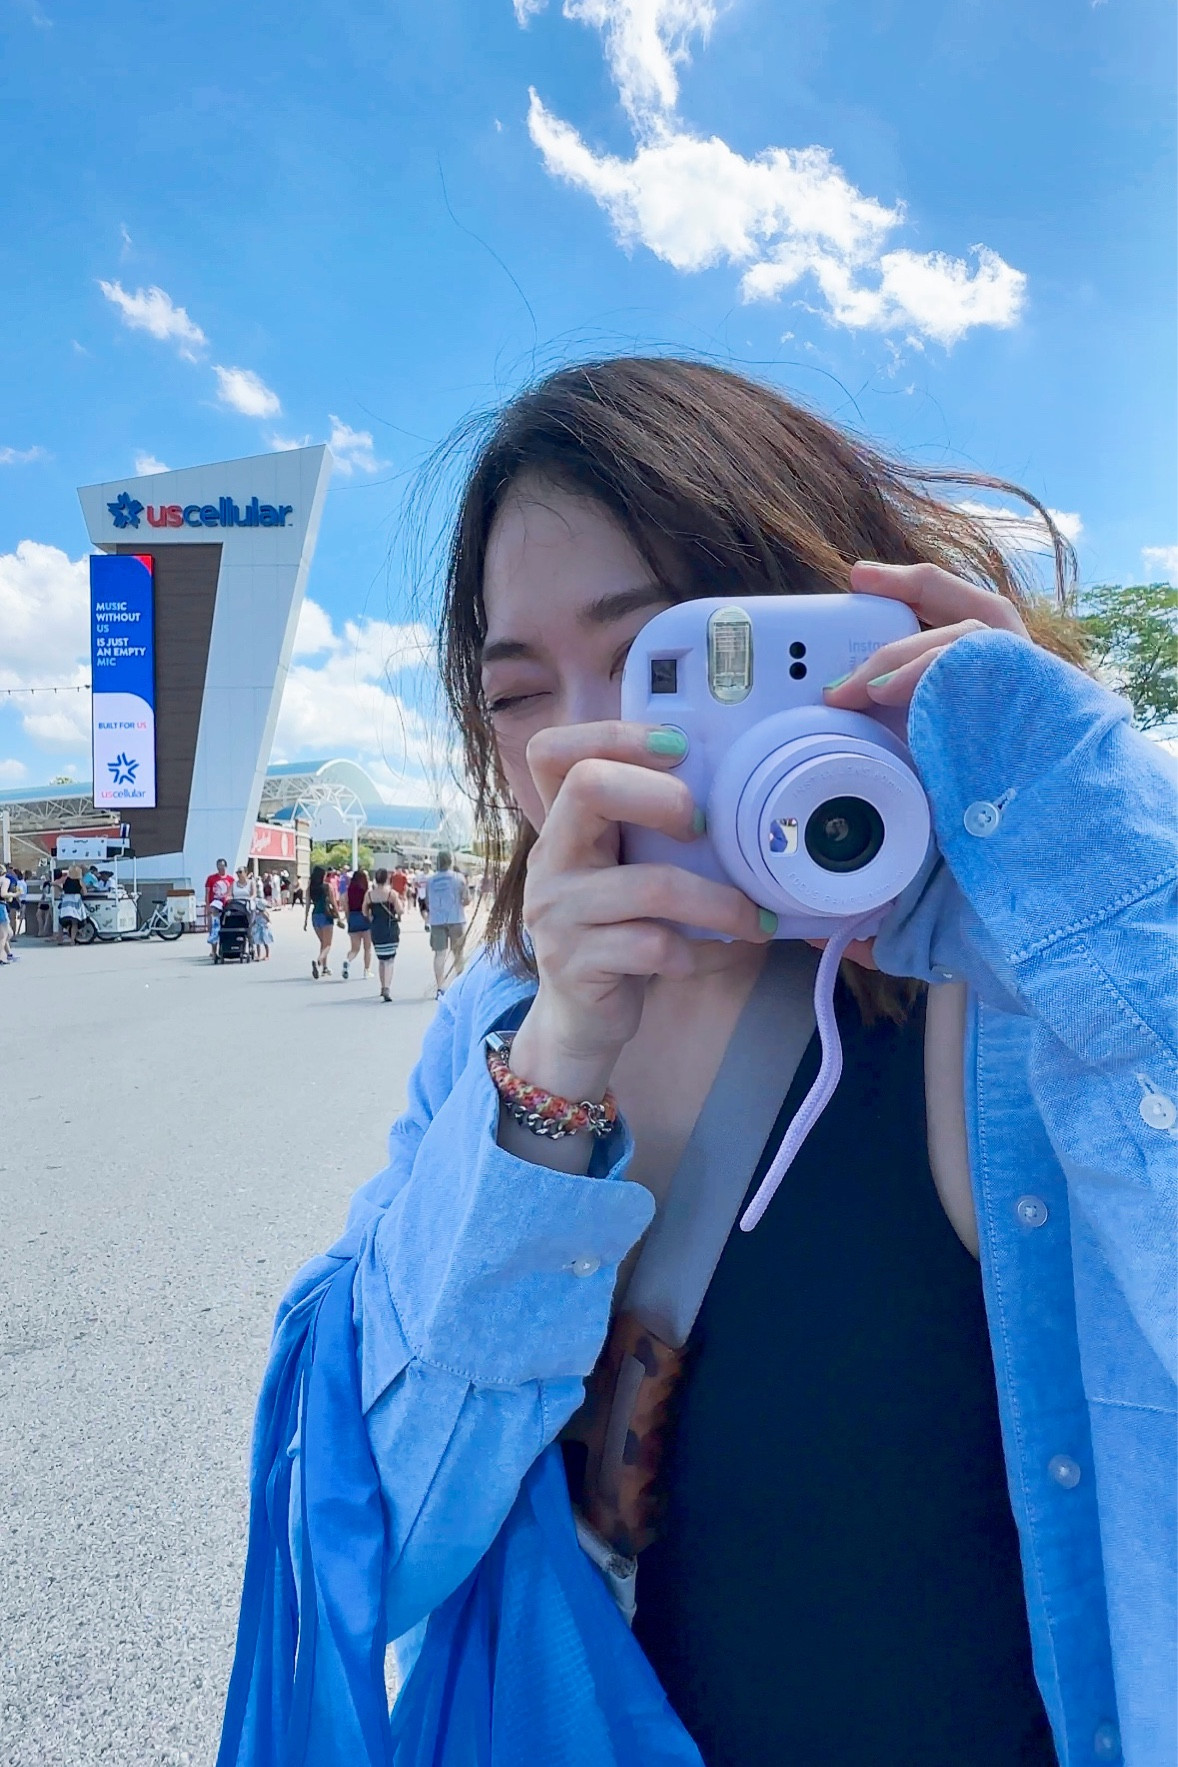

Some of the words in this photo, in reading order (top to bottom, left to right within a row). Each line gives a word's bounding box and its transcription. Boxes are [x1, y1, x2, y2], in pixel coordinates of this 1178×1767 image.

[146, 496, 294, 528] uscellular
[96, 602, 127, 612] MUSIC
[96, 613, 141, 622] WITHOUT
[96, 624, 109, 633] US
[96, 638, 106, 647] IS
[106, 637, 129, 647] JUST
[96, 647, 112, 657] AN
[113, 647, 146, 657] EMPTY
[97, 658, 117, 667] MIC
[98, 722, 118, 730] BUILT
[119, 722, 135, 730] FOR
[137, 722, 147, 730] US
[101, 789, 146, 799] uscellular
